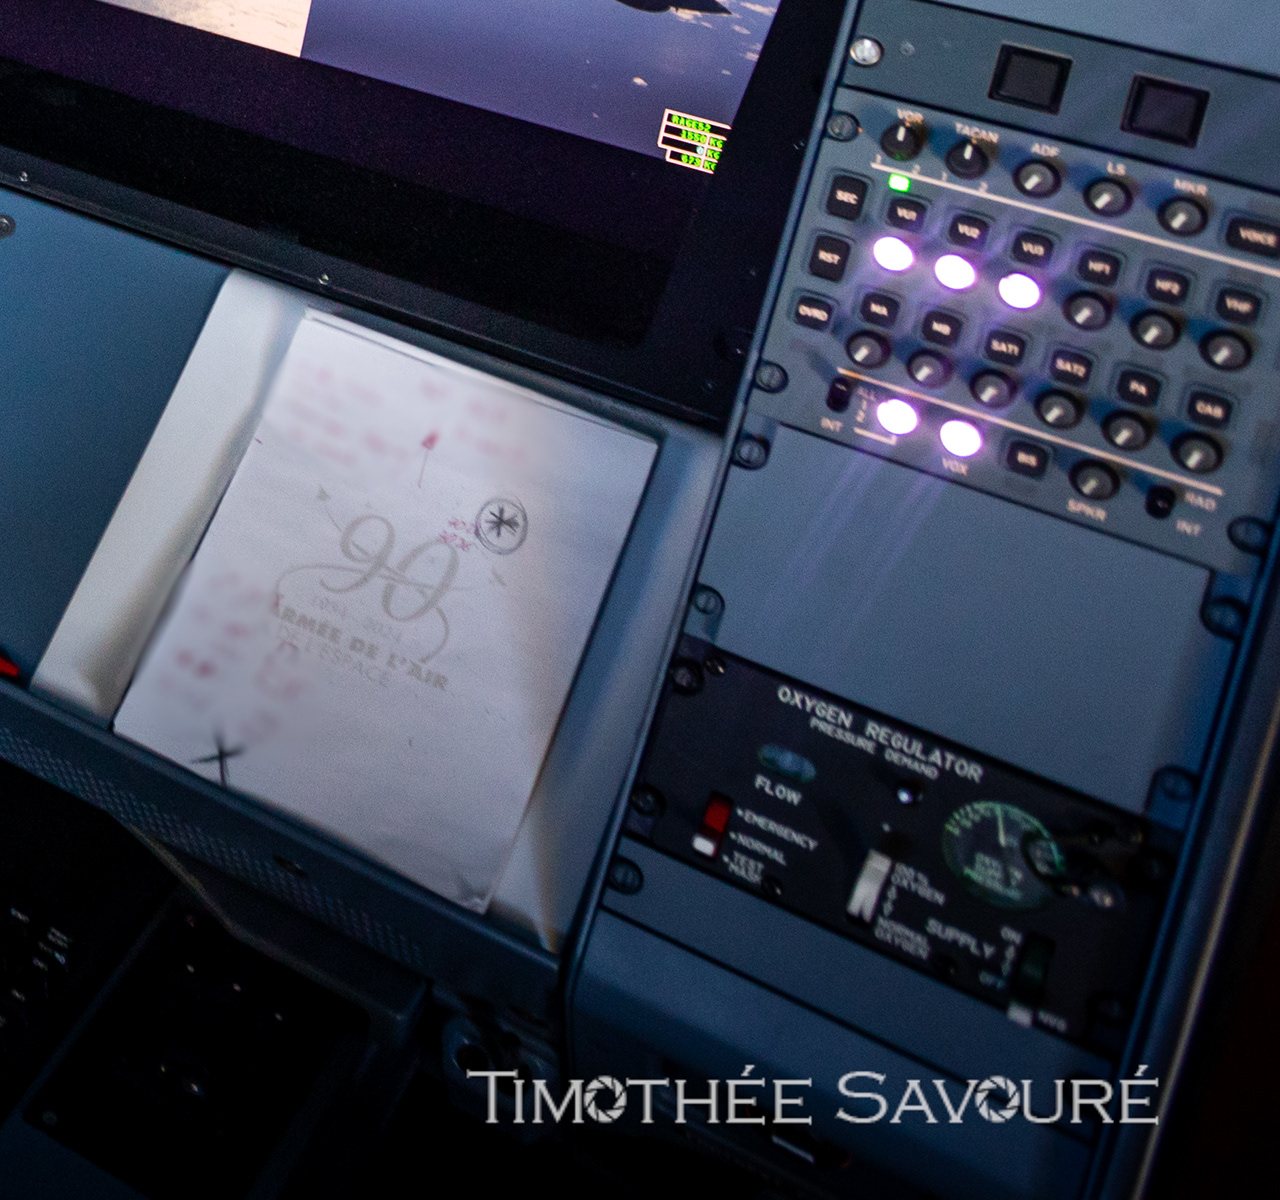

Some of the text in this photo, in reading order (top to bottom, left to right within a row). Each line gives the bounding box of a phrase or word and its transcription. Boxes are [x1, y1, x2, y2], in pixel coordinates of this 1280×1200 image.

[671, 114, 712, 133] RAGE52
[955, 122, 999, 144] TACAN
[680, 129, 724, 148] 1550 KG
[707, 148, 721, 160] KG
[1031, 143, 1060, 158] ADF
[1107, 161, 1127, 176] LS
[942, 457, 968, 476] VOX
[777, 685, 984, 783] OXYGEN REGULATOR
[810, 716, 939, 780] PRESSURE DEMAND
[754, 774, 802, 806] FLOW
[743, 809, 819, 851] EMERGENCY
[925, 916, 996, 960] SUPPLY
